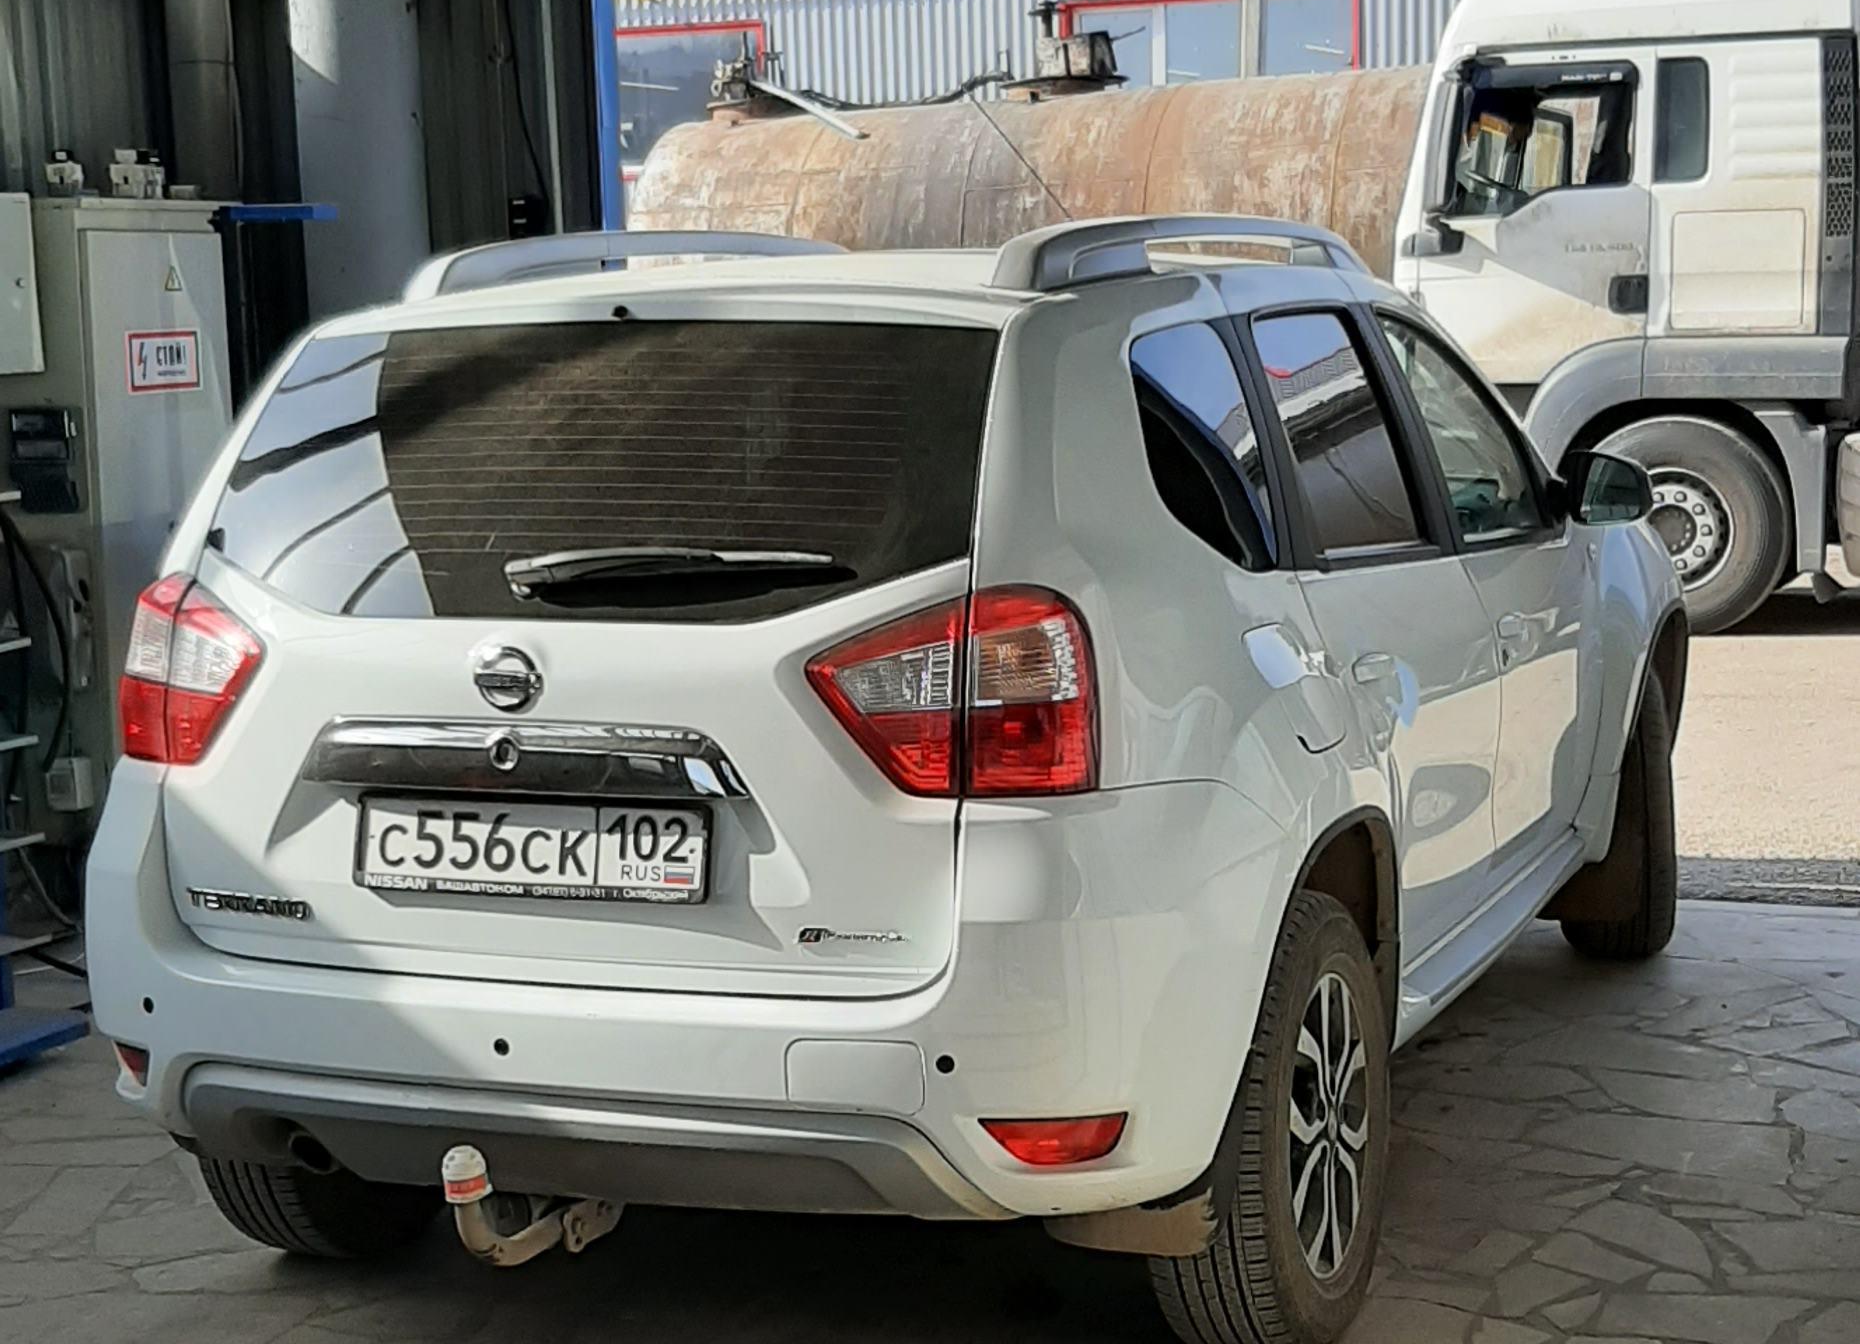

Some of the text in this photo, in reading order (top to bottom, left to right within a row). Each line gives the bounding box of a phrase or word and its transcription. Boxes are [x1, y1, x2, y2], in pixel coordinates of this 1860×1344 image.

[606, 814, 688, 864] 102
[364, 873, 428, 891] NISSAN
[620, 864, 661, 882] RUS
